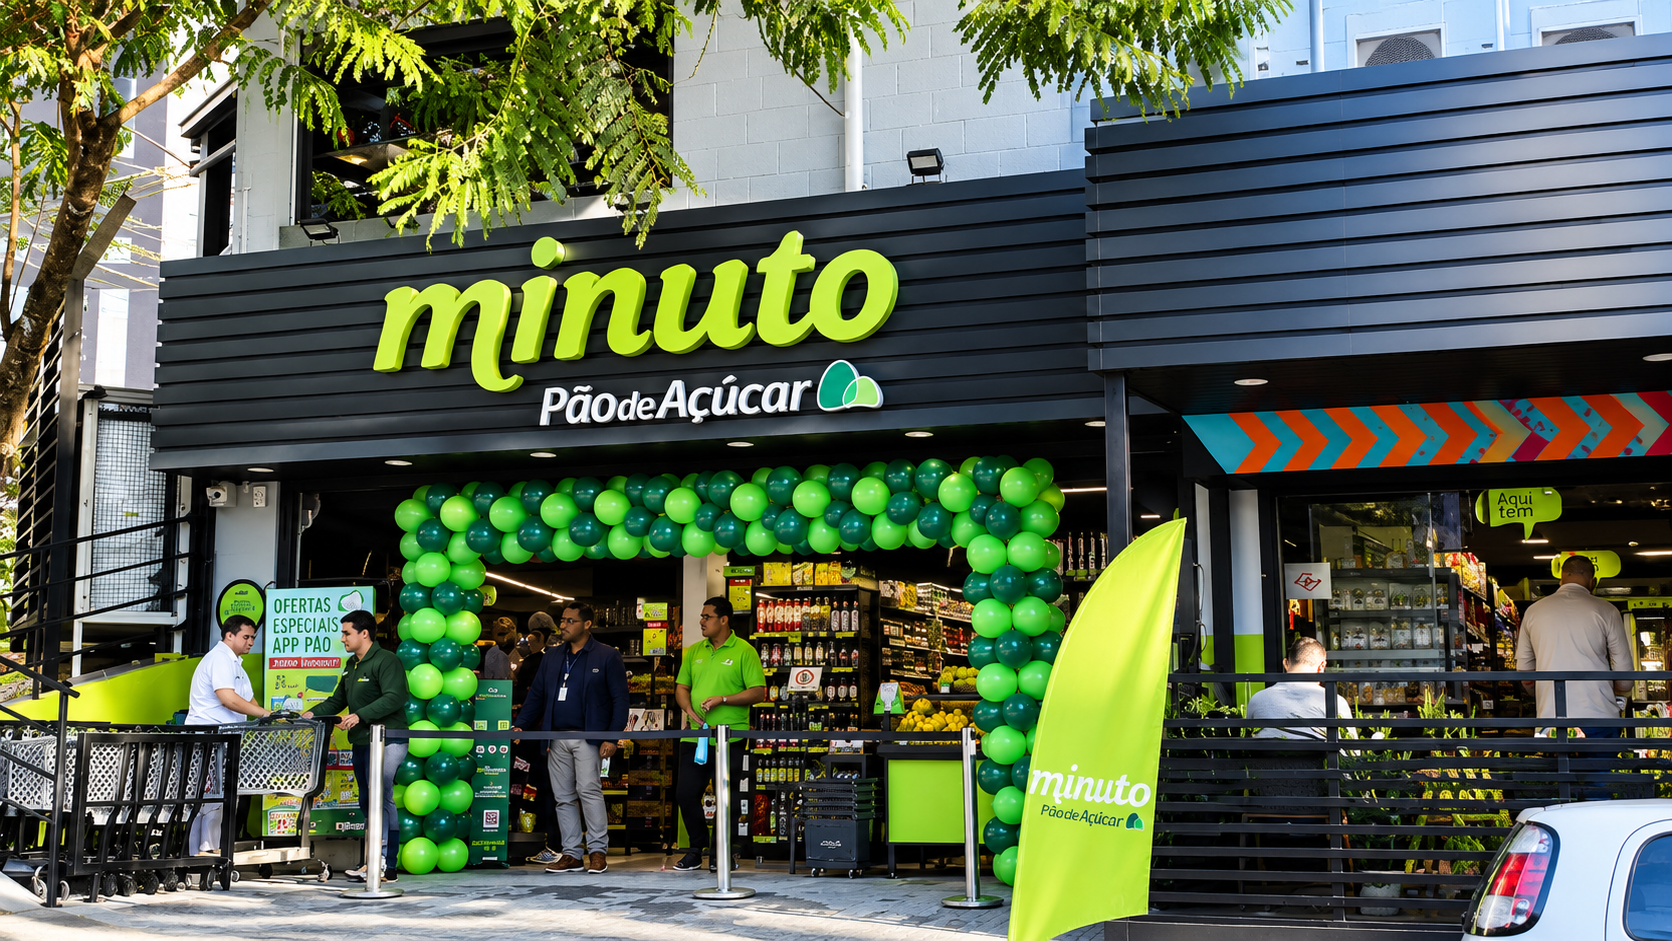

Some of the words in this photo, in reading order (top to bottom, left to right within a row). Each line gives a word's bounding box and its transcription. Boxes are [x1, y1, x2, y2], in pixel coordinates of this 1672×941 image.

[373, 230, 899, 392] minuto
[1497, 491, 1533, 508] Aqui
[1499, 506, 1534, 519] tem
[274, 597, 331, 614] OFERTAS
[273, 617, 339, 634] ESPECIAIS
[272, 637, 299, 654] APP
[1029, 763, 1152, 808] minuto
